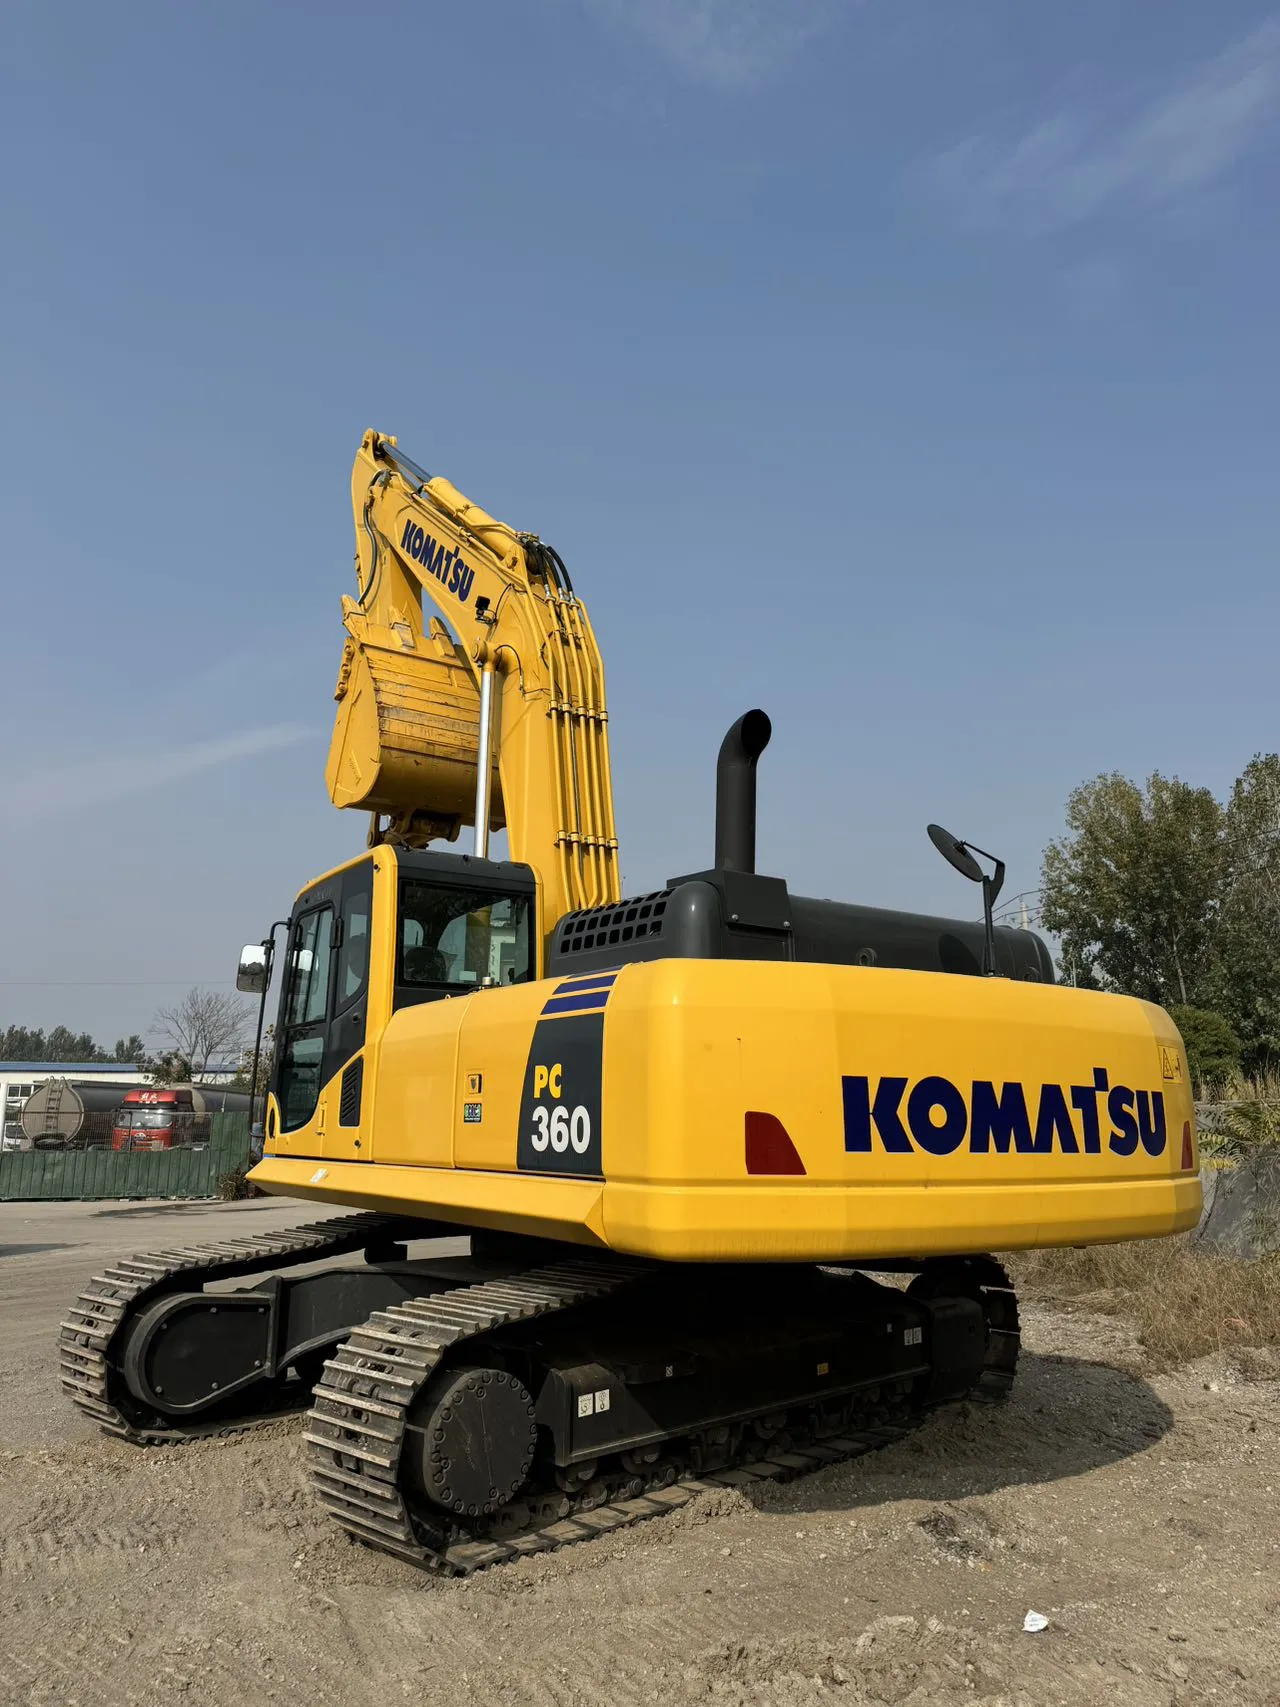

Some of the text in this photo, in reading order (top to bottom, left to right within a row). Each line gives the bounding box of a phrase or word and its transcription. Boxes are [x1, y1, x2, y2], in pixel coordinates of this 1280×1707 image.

[400, 518, 476, 602] KOMATSU
[533, 1063, 562, 1099] PC
[841, 1067, 1167, 1156] KOMATSU
[531, 1105, 591, 1154] 360
